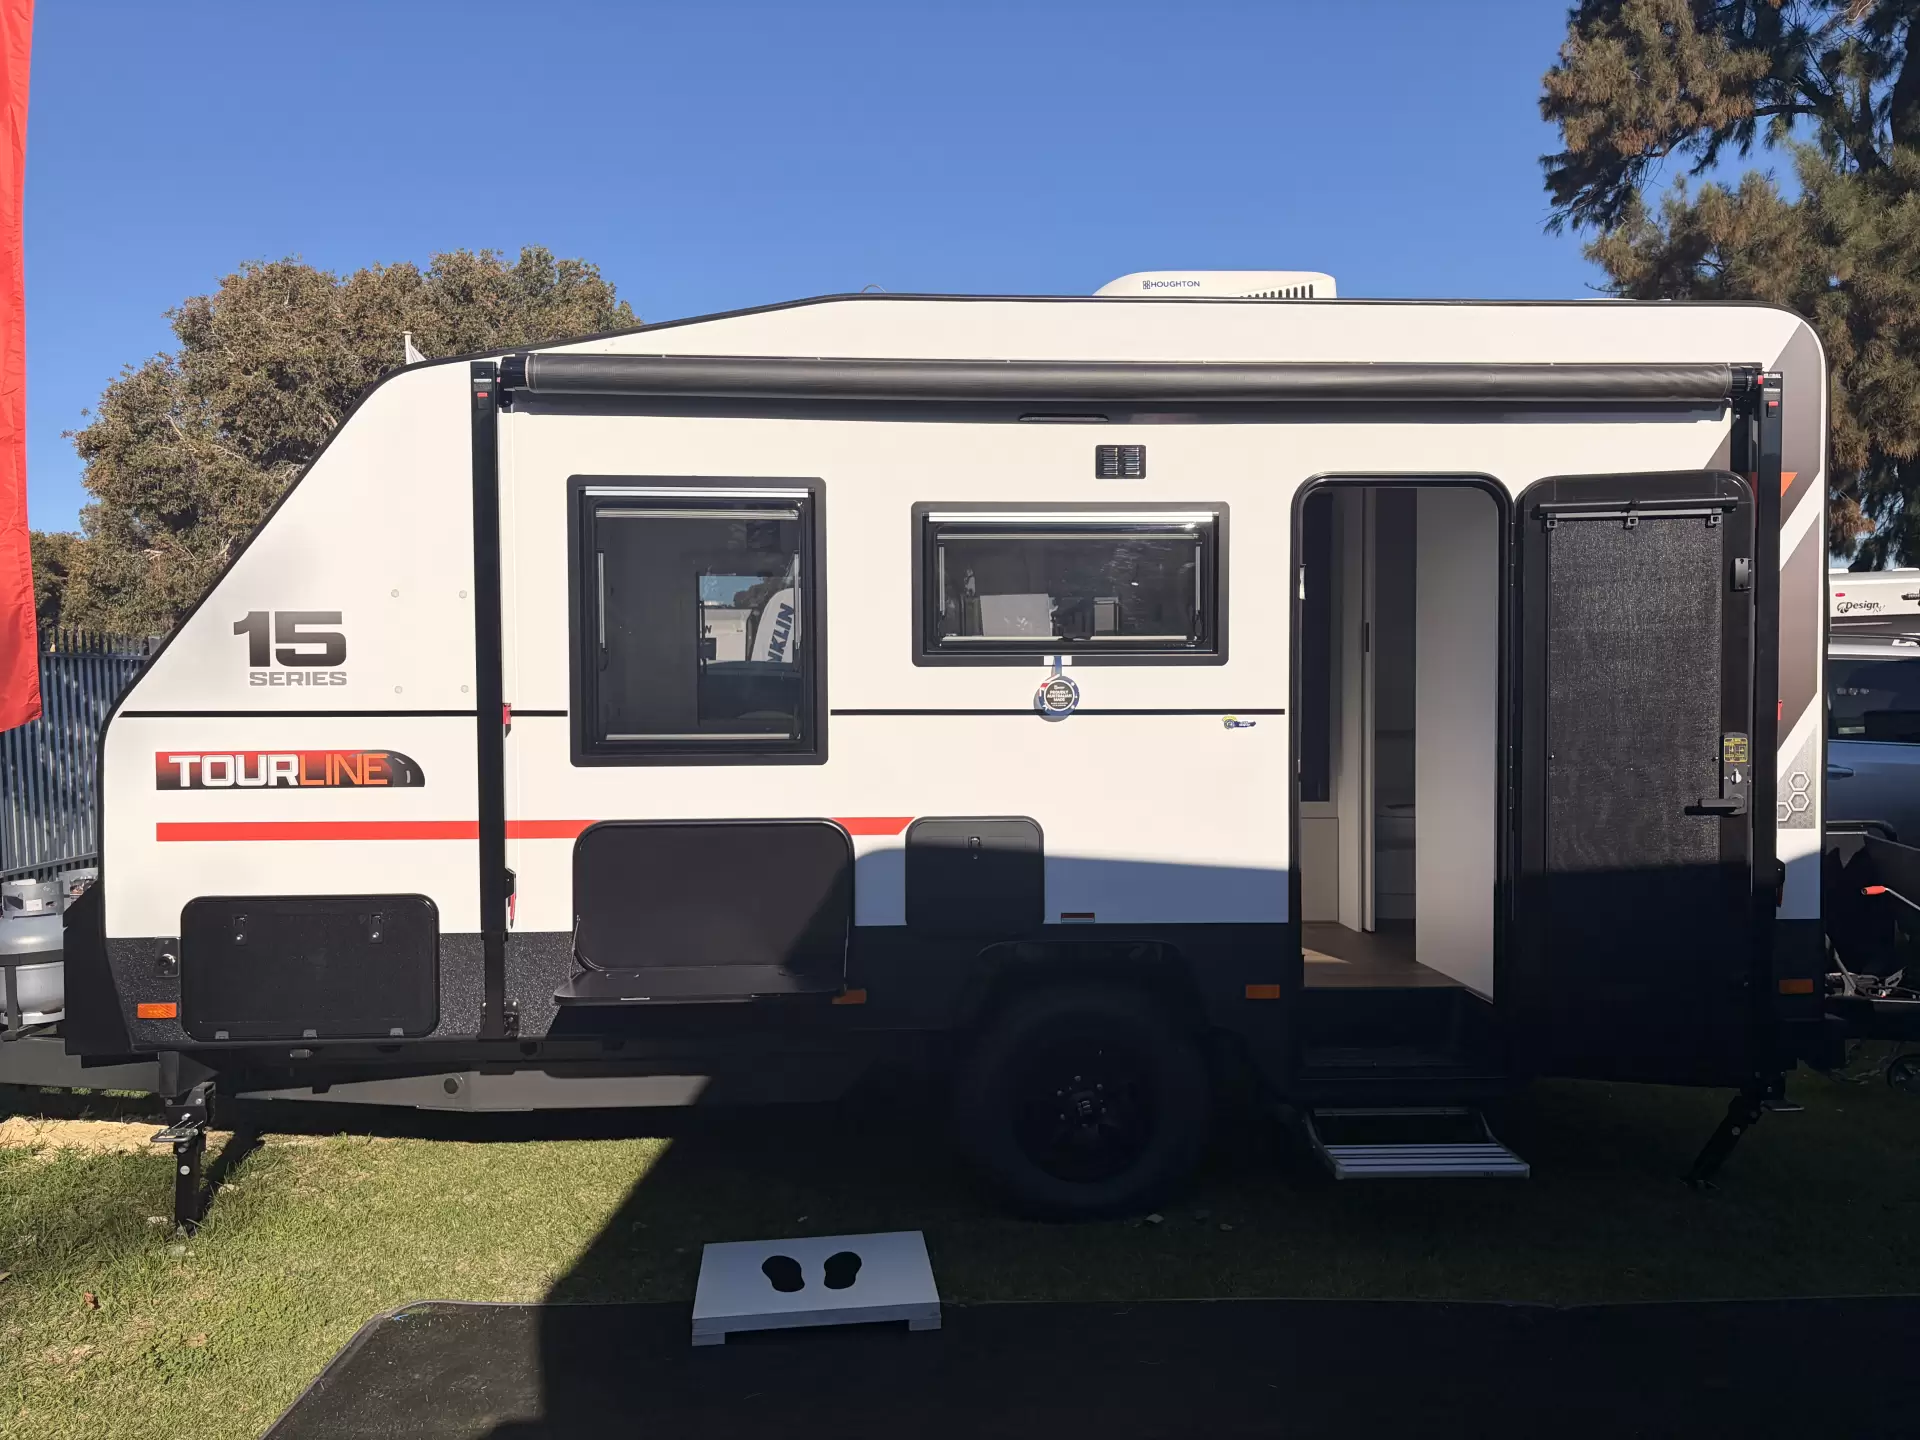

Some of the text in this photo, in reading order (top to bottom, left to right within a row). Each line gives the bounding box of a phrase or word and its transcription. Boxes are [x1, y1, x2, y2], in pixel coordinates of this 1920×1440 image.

[1845, 600, 1880, 611] Design
[233, 611, 347, 667] 15
[249, 671, 347, 686] SERIES
[168, 753, 390, 788] TOURLINE
